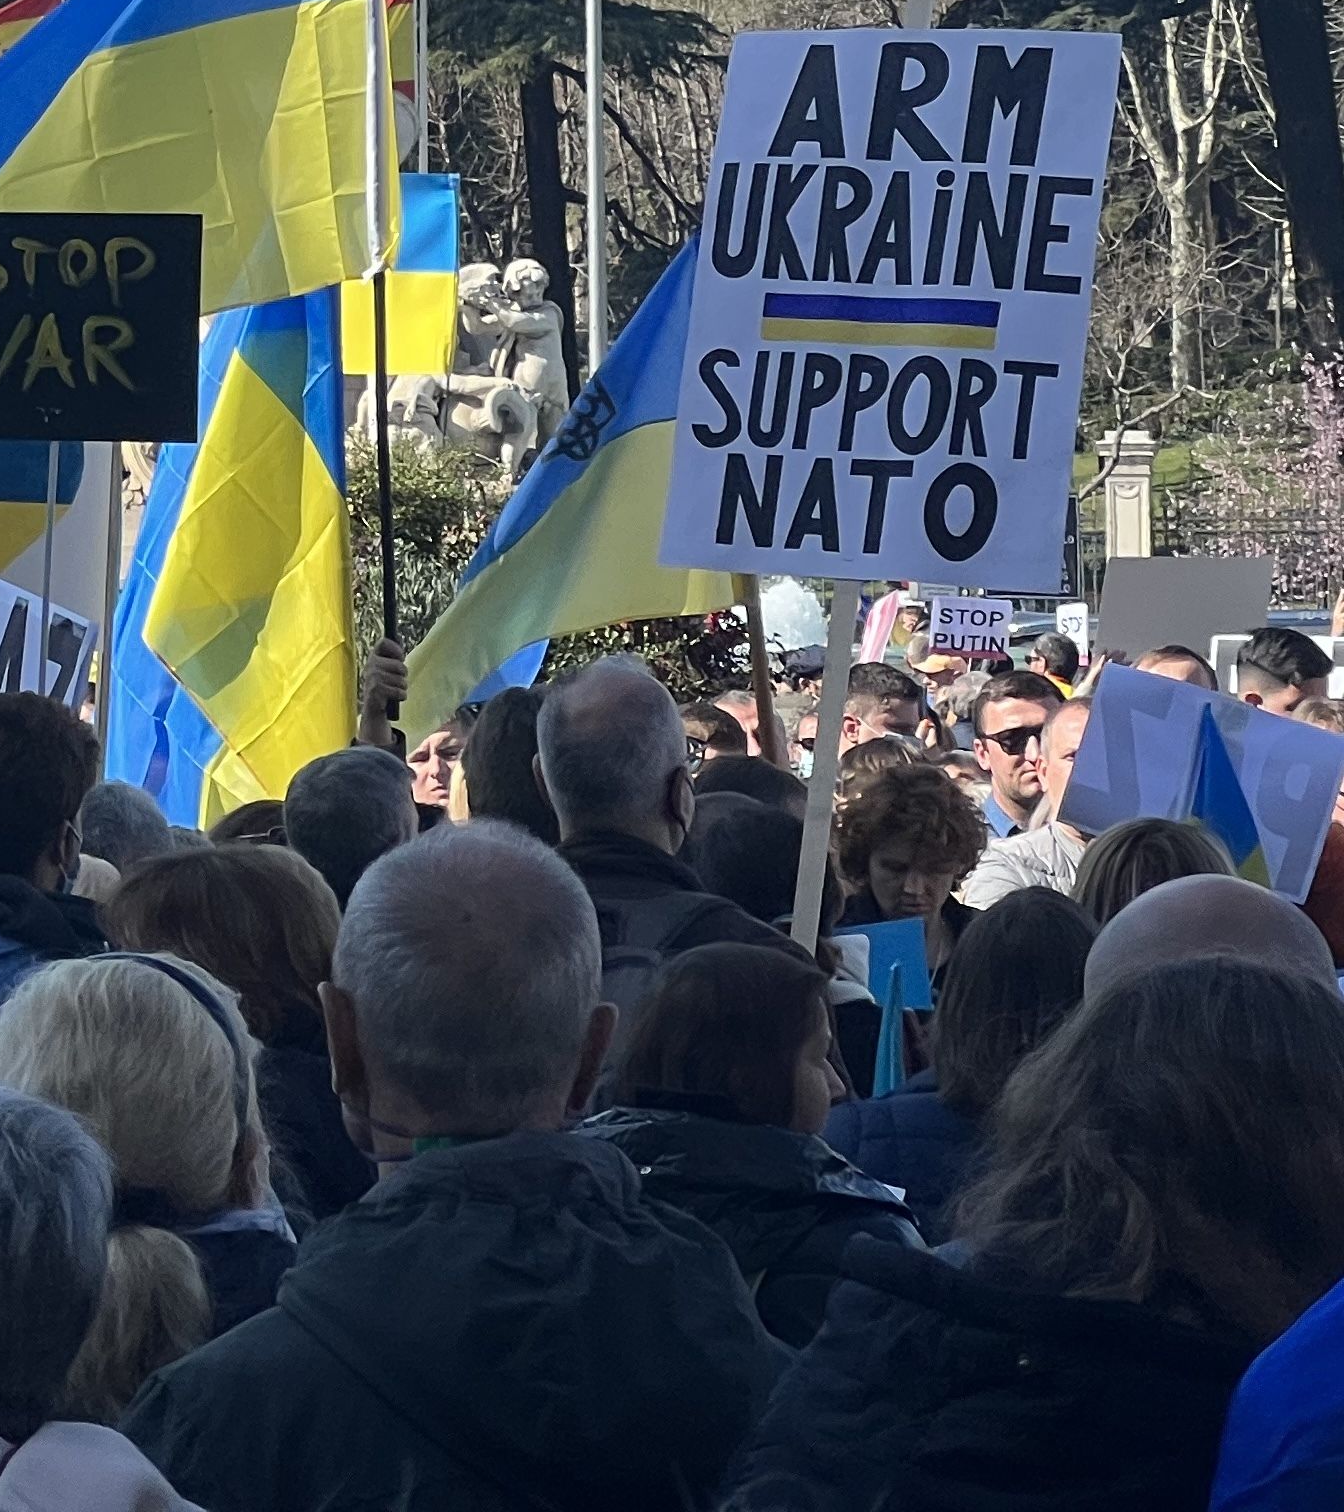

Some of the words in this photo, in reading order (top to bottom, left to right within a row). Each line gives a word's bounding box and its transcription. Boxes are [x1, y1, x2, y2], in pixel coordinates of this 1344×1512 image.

[767, 41, 1054, 167] ARM
[691, 348, 1060, 460] SUPPORT
[715, 453, 999, 562] NATO
[933, 633, 1006, 654] PUTIN
[938, 607, 1005, 628] STOP
